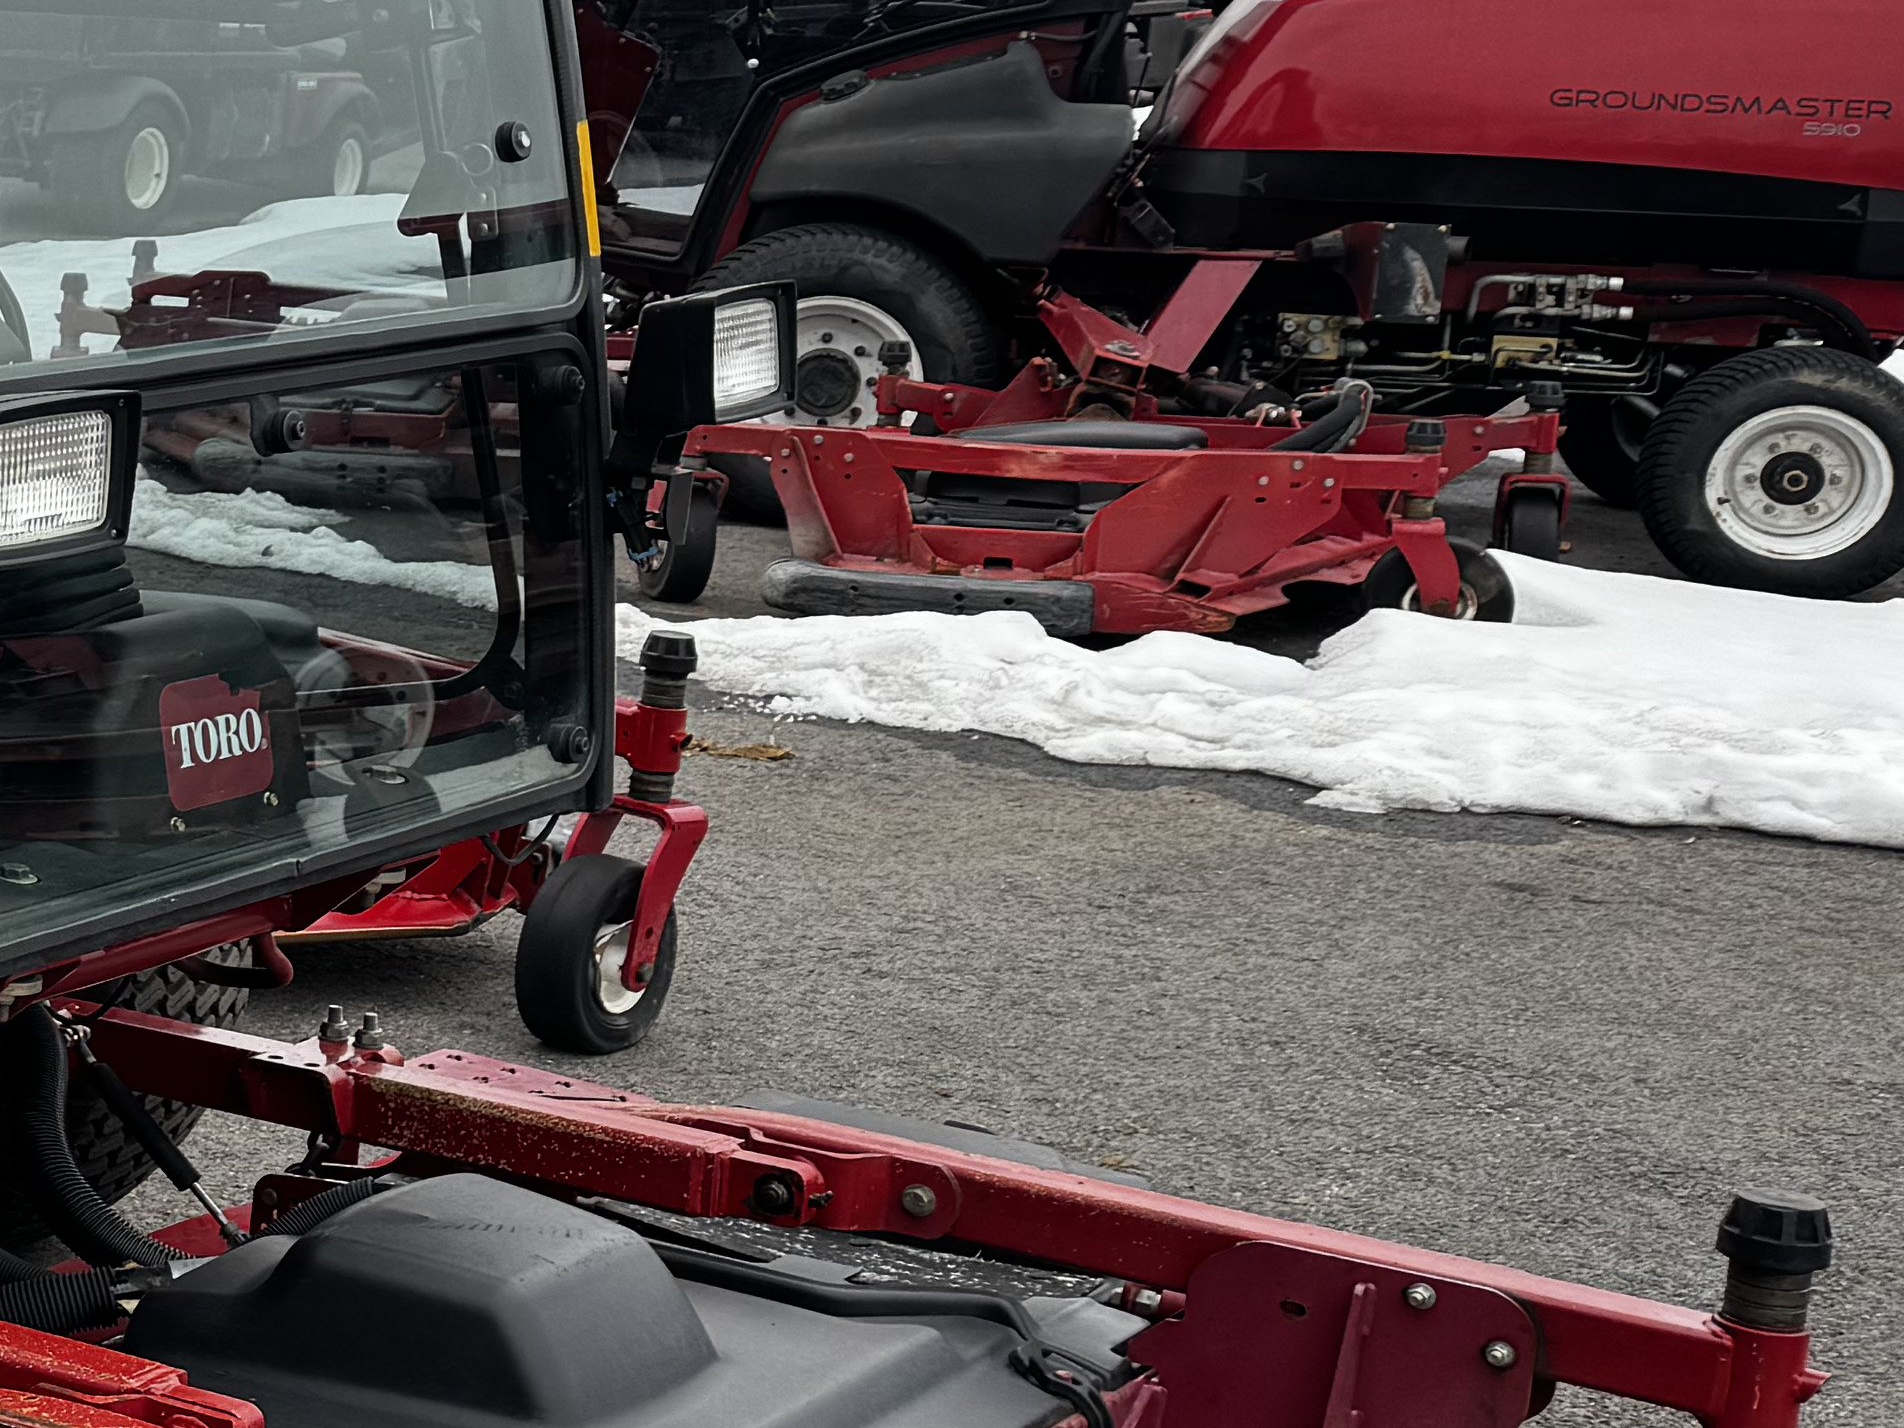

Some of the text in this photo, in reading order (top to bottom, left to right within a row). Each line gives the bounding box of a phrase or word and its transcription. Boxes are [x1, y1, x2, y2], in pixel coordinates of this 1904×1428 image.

[1549, 88, 1893, 119] GROUNDSMASTER
[1803, 122, 1861, 137] 5910
[171, 708, 263, 769] TORO
